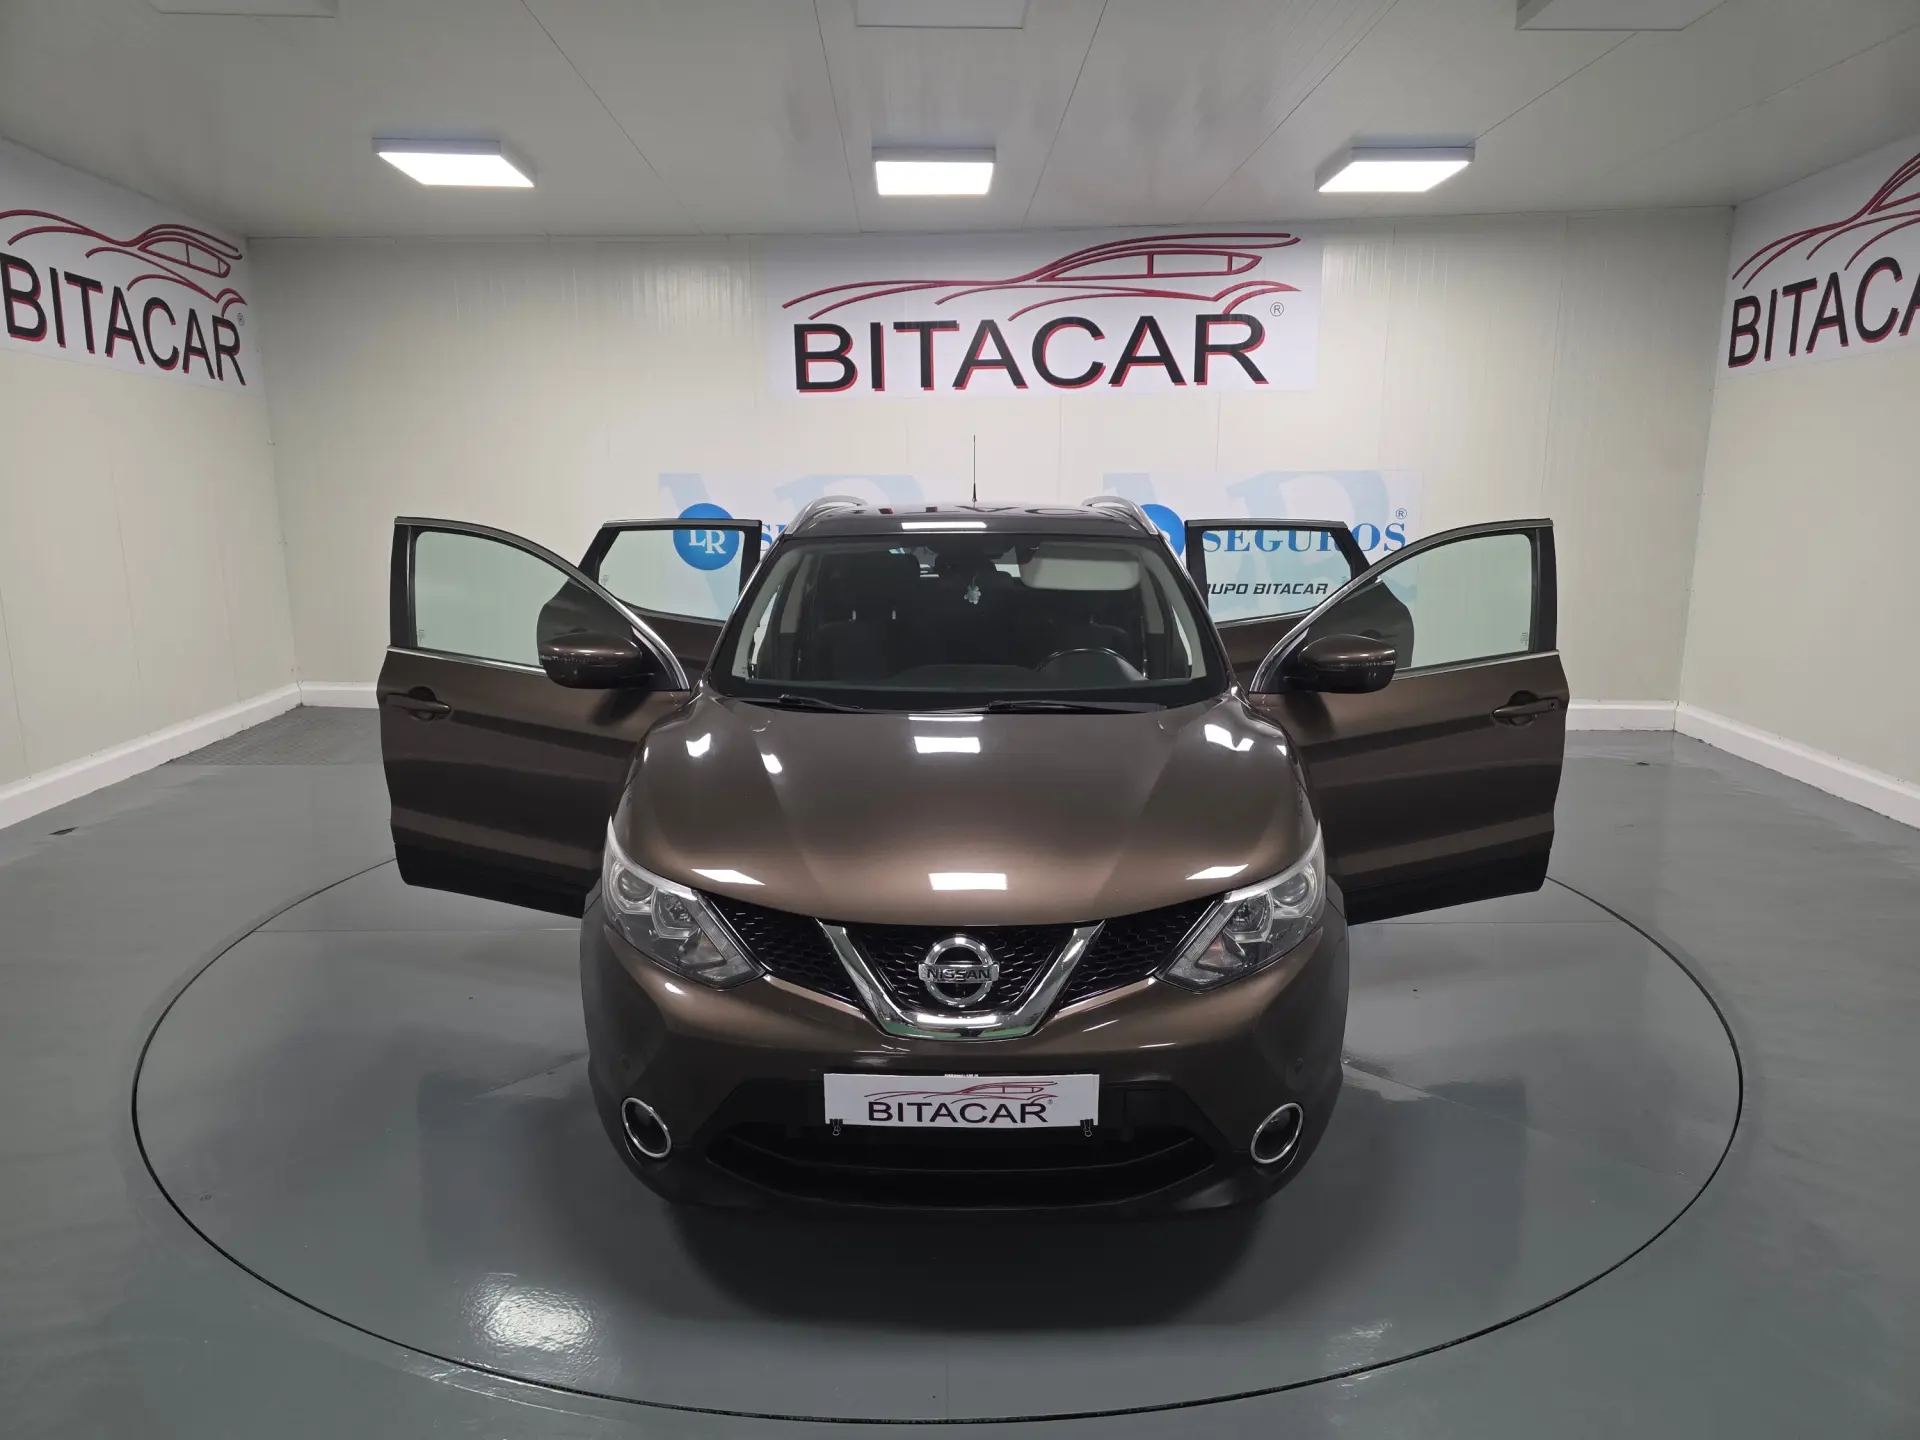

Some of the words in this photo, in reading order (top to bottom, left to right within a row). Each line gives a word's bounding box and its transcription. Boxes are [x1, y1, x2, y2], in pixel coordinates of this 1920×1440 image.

[0, 252, 247, 386] BITACAR
[794, 314, 1269, 392] BITACAR
[1252, 583, 1329, 595] BITACAR
[926, 967, 991, 981] NISSAN
[868, 1101, 1049, 1124] BITACAR
